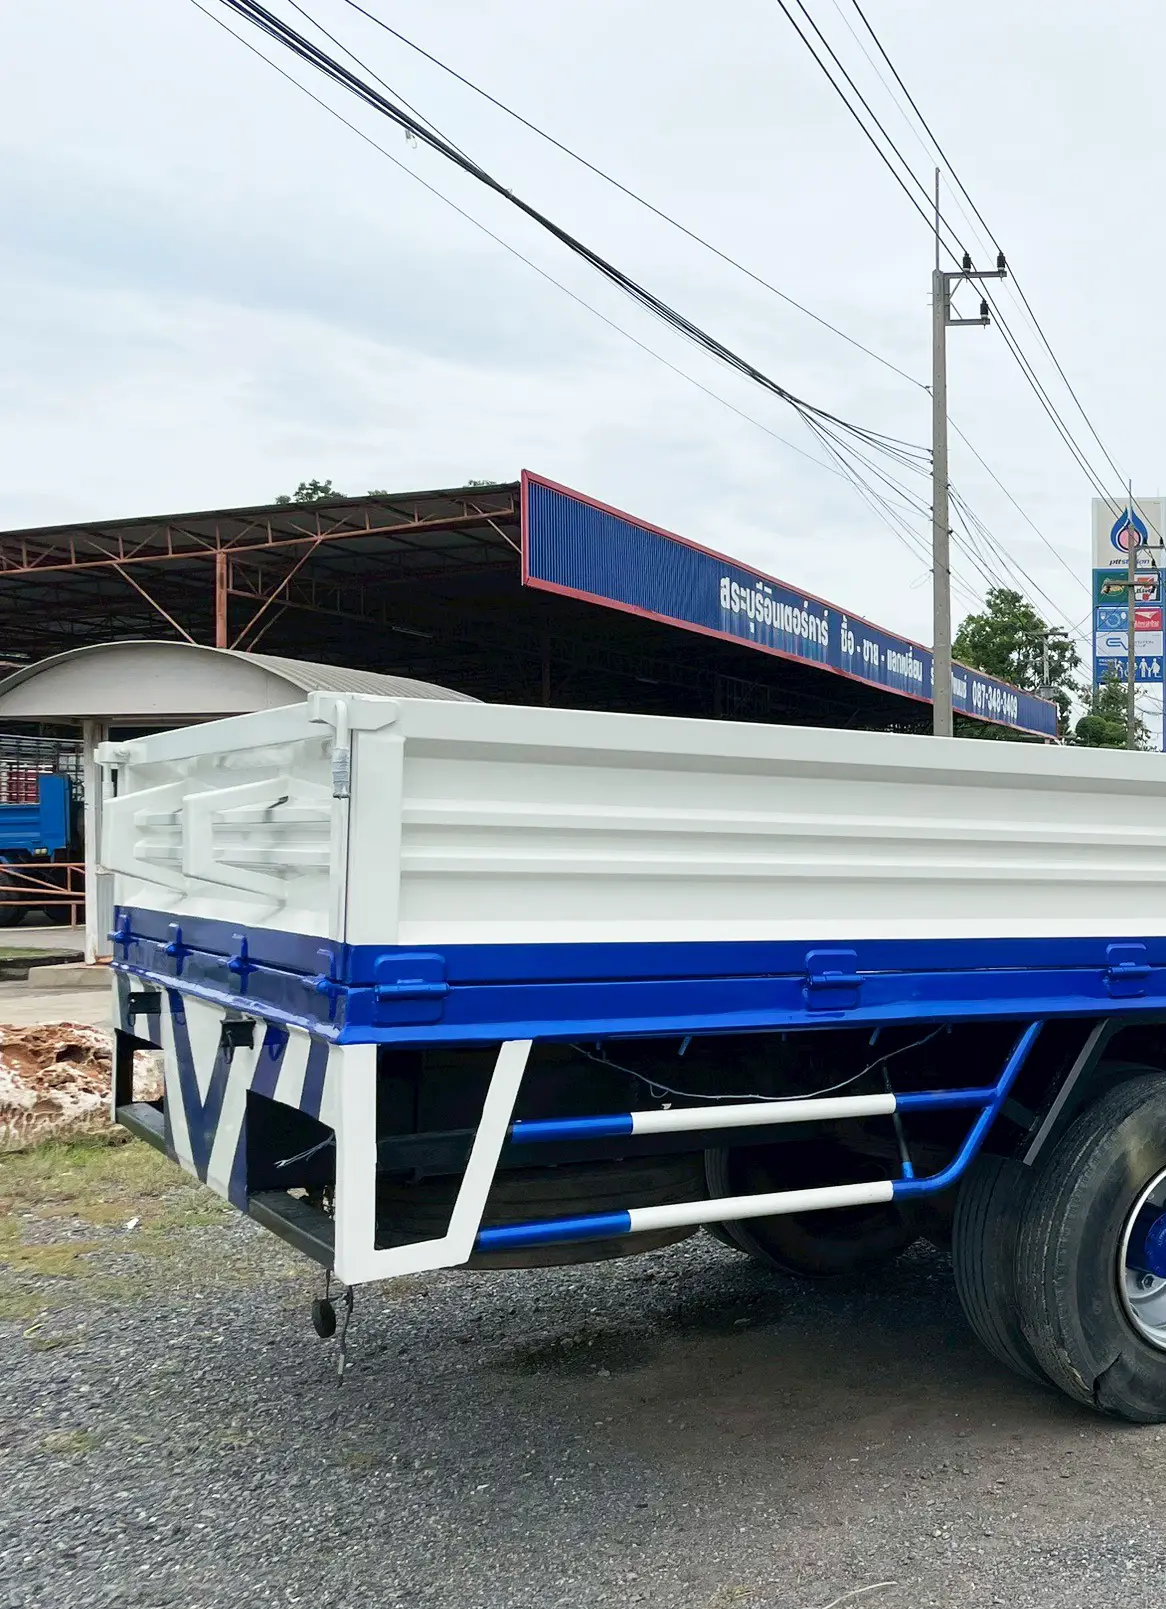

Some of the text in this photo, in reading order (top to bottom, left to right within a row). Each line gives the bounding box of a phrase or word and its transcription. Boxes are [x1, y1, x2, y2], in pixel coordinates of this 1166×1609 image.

[720, 577, 829, 646] สระบุรีอินเตอร์คาร์
